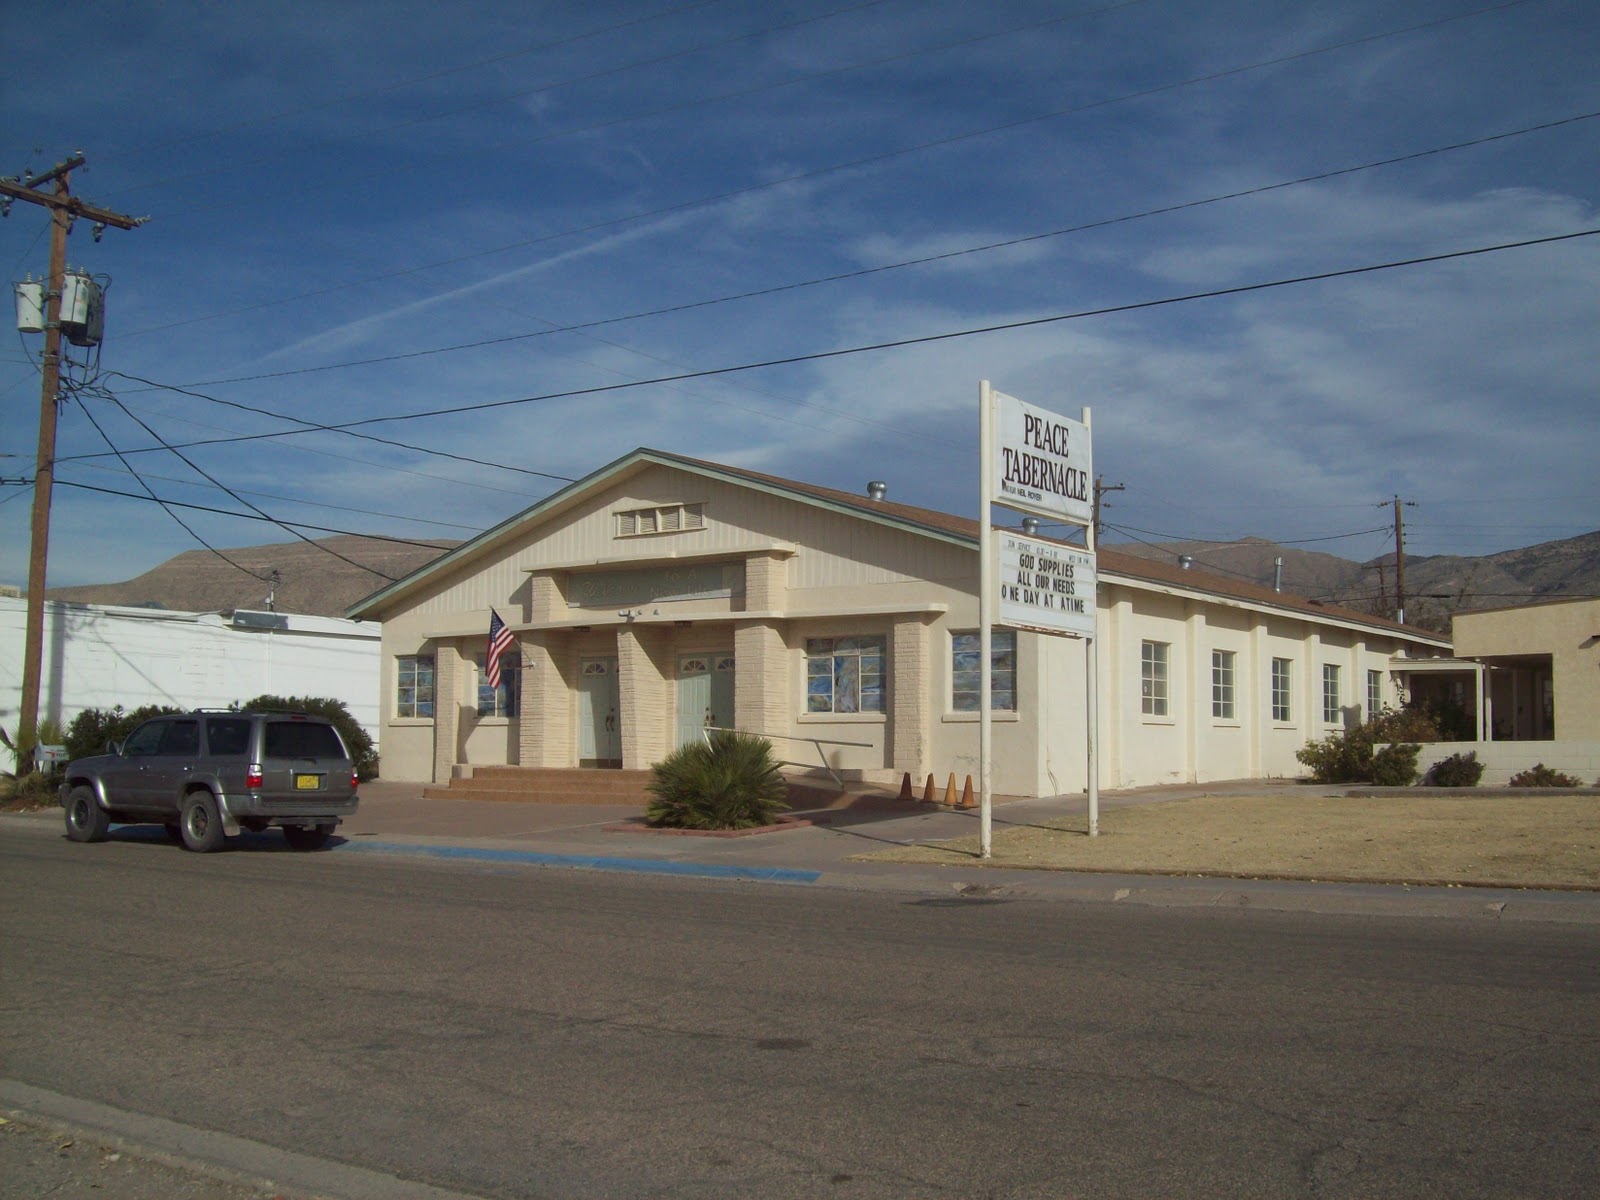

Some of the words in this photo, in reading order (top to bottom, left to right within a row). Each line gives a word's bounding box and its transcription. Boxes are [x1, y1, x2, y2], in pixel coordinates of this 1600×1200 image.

[1024, 413, 1069, 458] PEACE
[1003, 447, 1087, 502] TABERNACLE
[1019, 553, 1034, 570] GOD
[1038, 558, 1074, 578] SUPPLIES
[1017, 571, 1031, 587] ALL
[1035, 574, 1050, 590] OUR
[1053, 578, 1075, 595] NEEDS
[1023, 588, 1040, 606] DAY
[1044, 593, 1054, 609] AT
